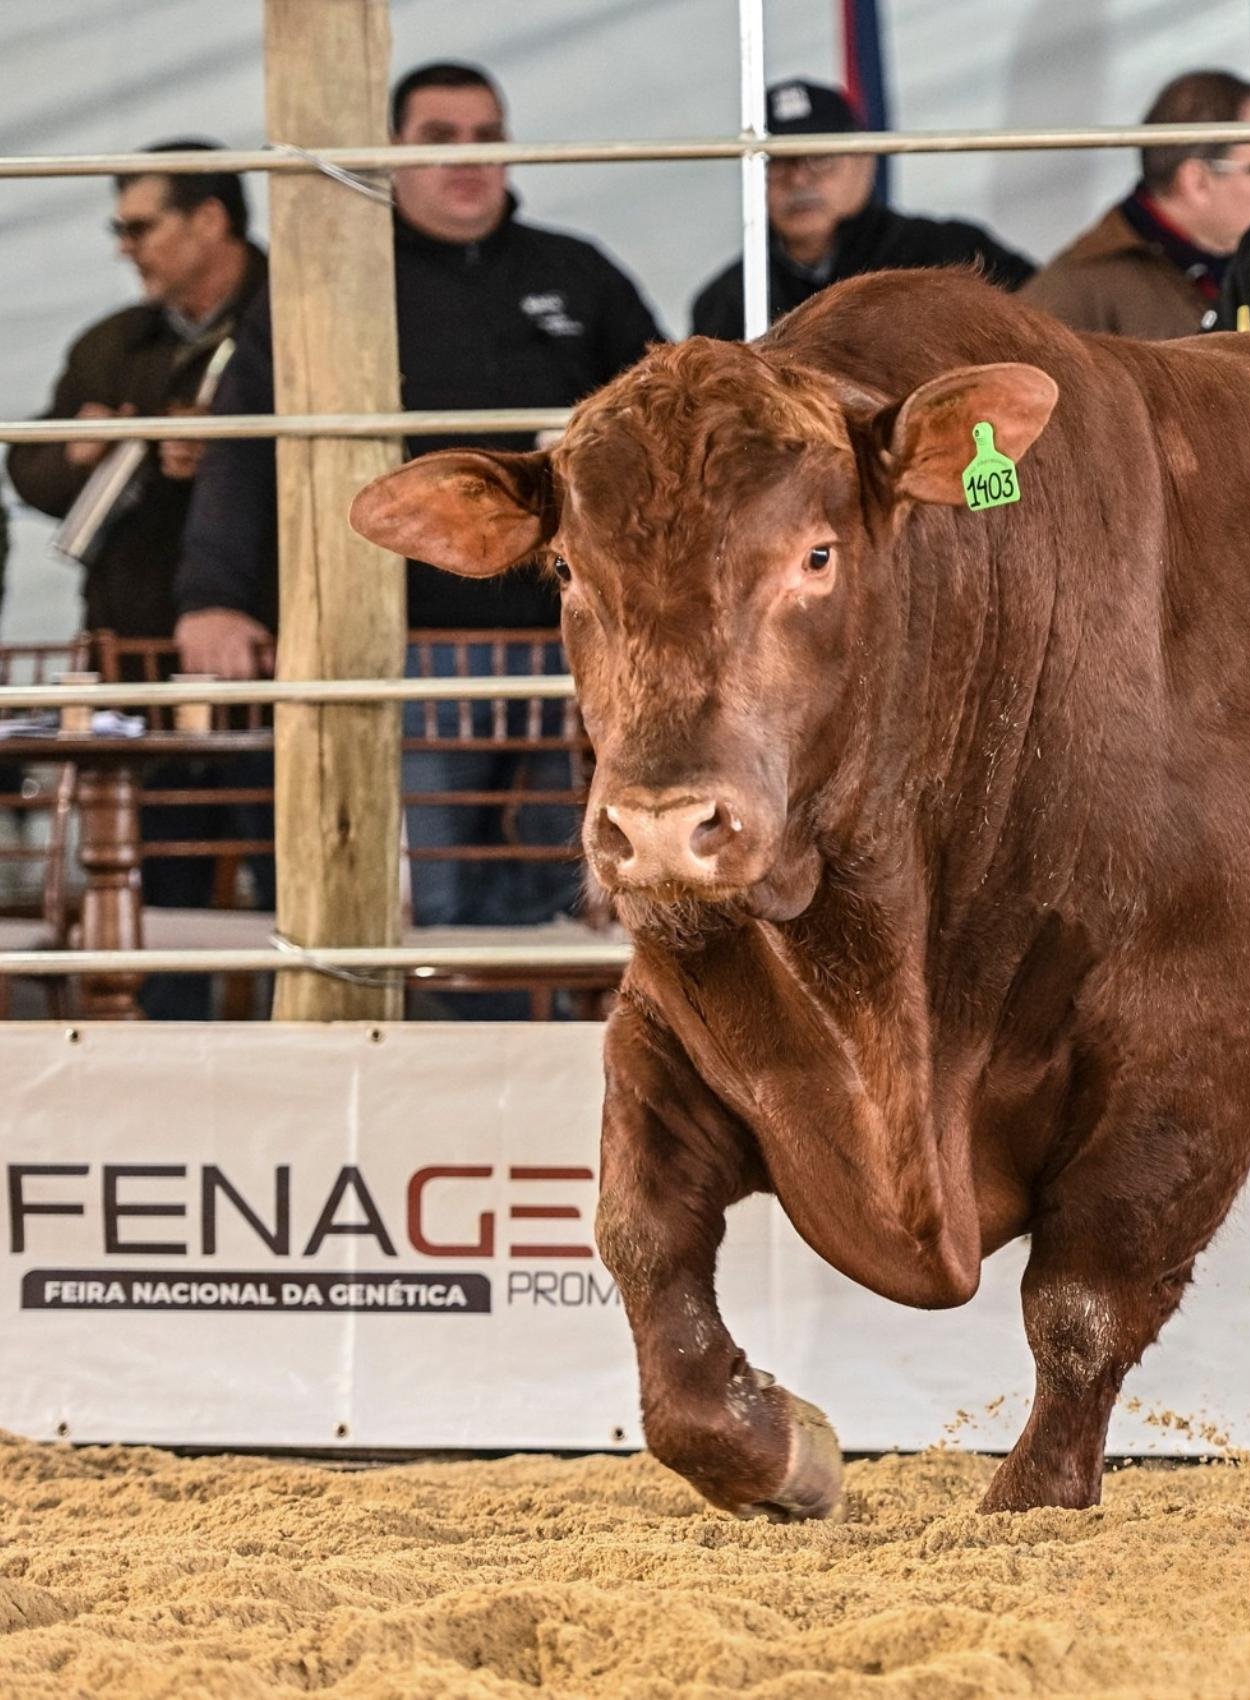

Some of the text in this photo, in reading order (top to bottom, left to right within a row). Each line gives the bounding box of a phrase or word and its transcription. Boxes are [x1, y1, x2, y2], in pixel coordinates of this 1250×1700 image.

[967, 469, 1014, 507] 1403
[8, 1165, 594, 1257] FENAGE
[45, 1279, 467, 1306] FEIRA NACIONAL DA GENÉTICA
[508, 1271, 620, 1305] PROM
